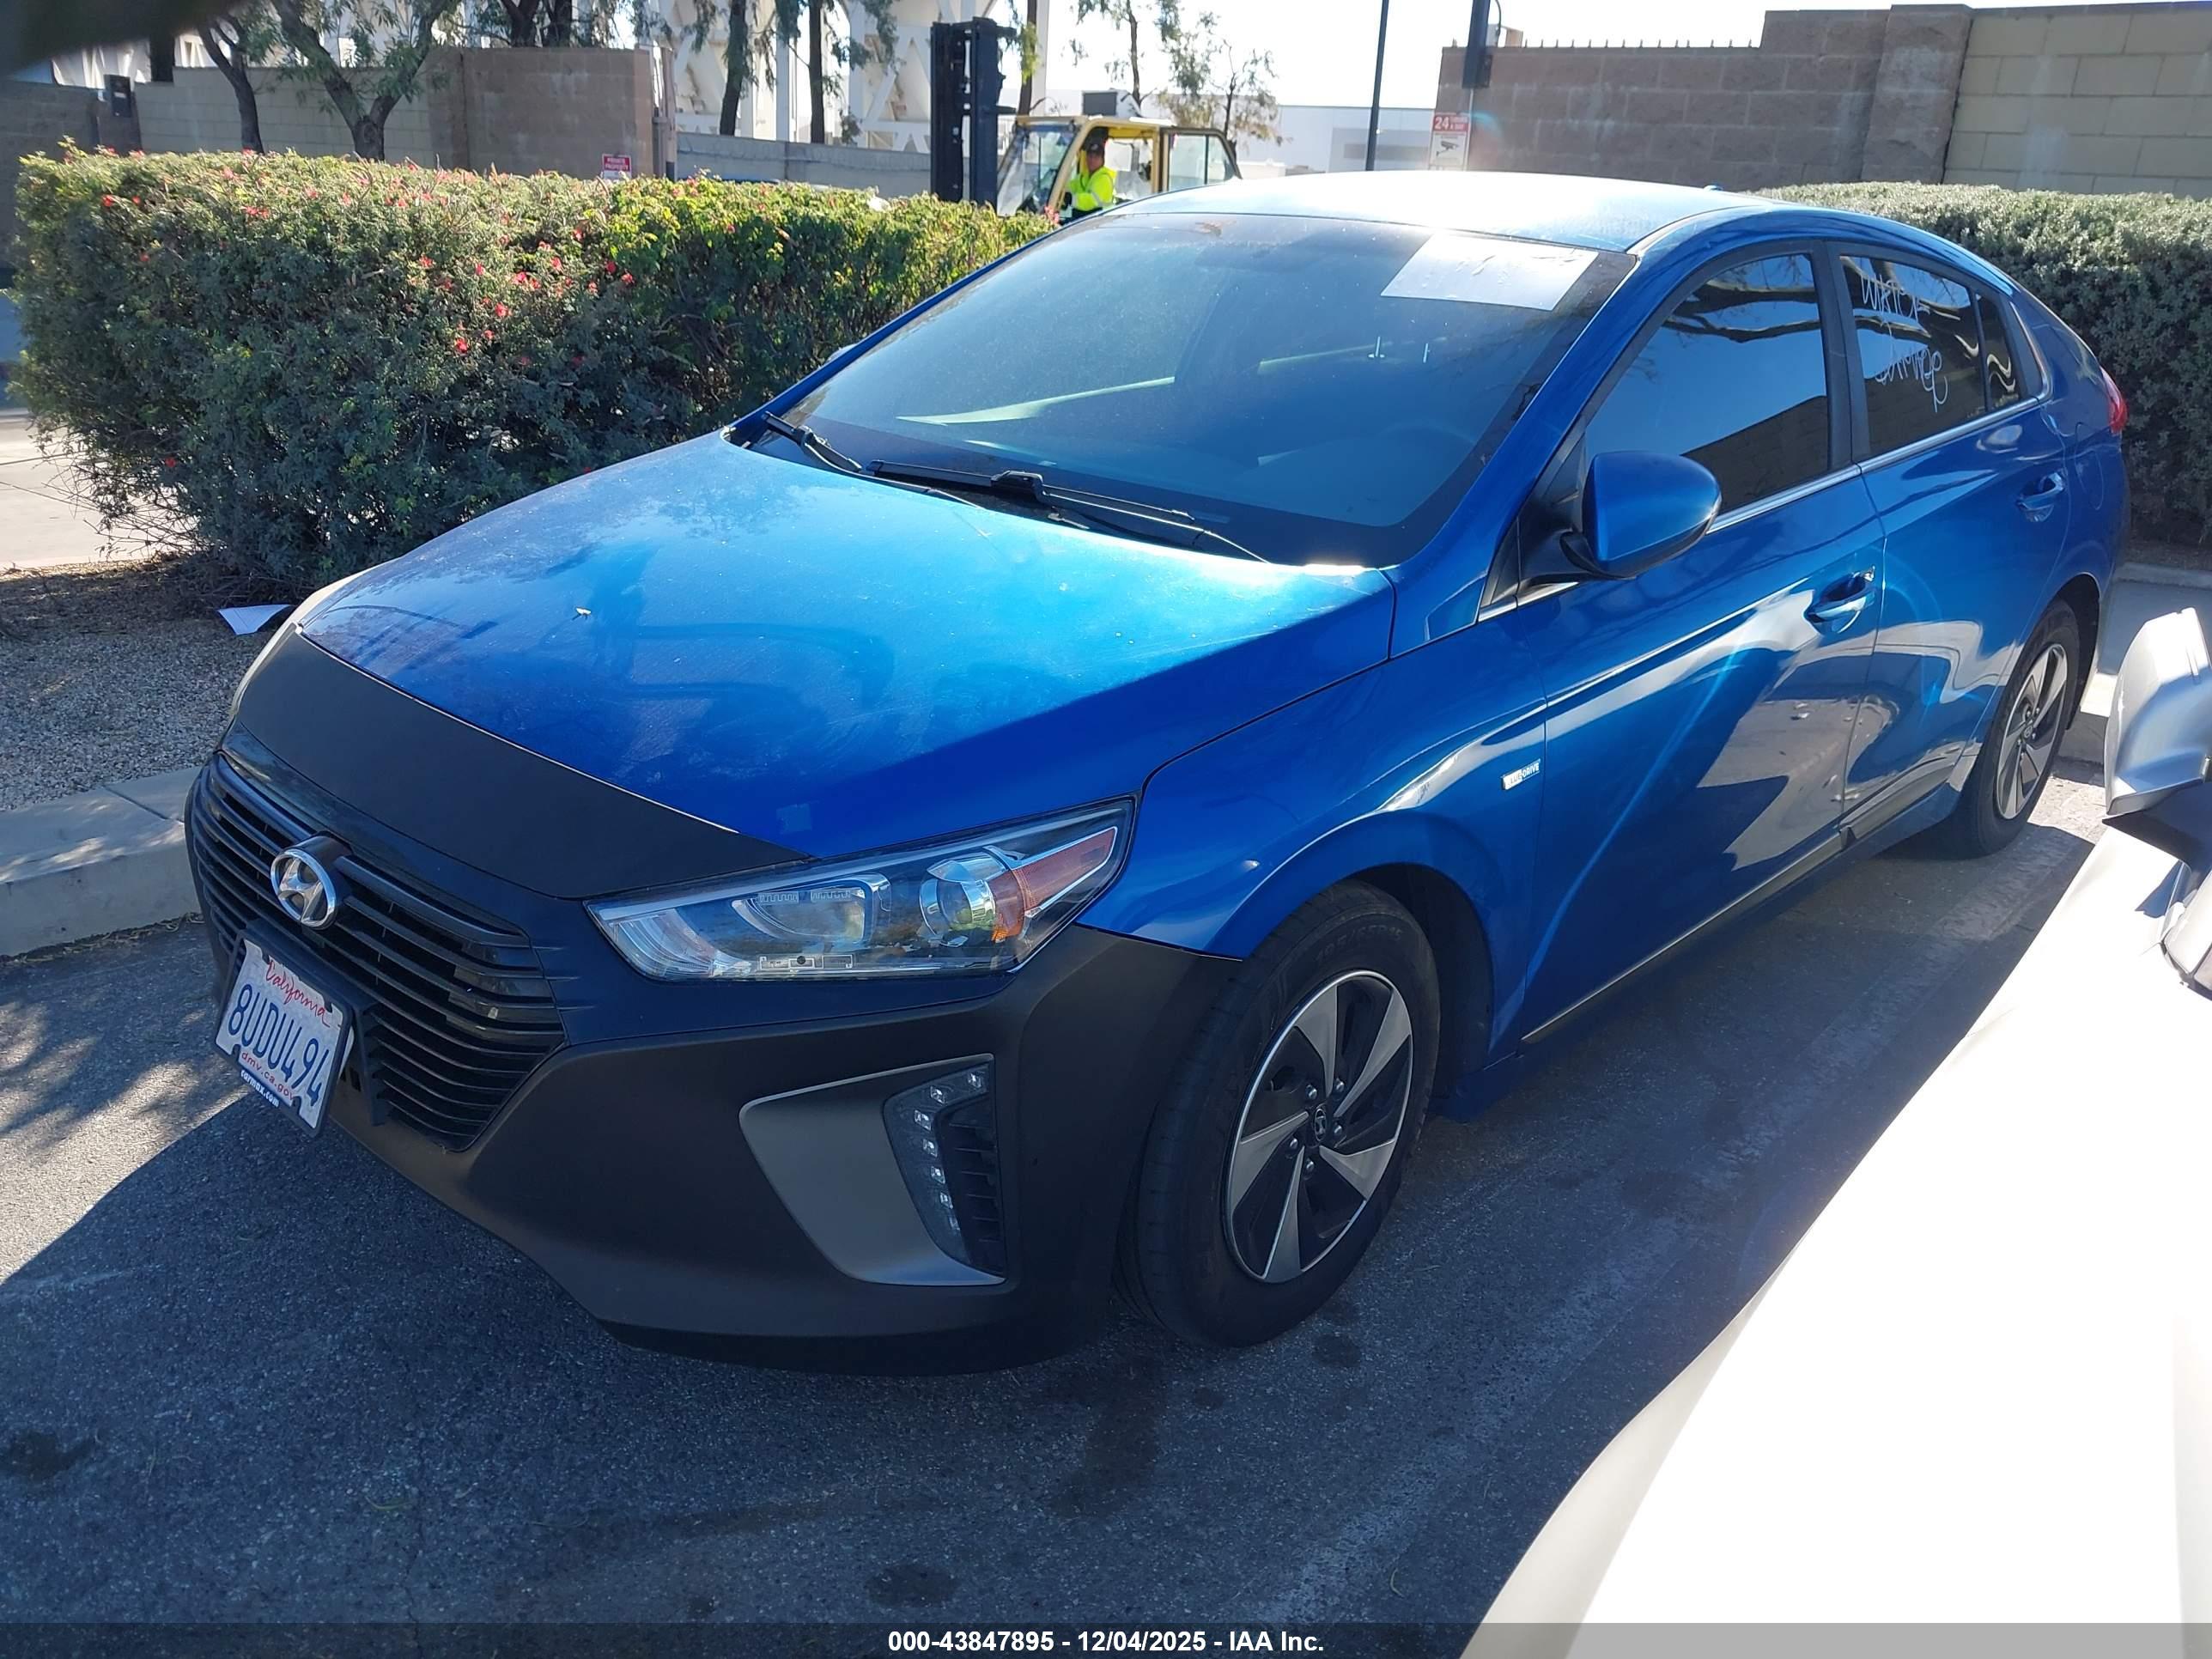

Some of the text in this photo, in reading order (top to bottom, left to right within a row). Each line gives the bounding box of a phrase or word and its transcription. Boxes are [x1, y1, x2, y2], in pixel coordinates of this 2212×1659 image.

[1434, 116, 1449, 130] 24
[265, 960, 331, 1028] California
[228, 983, 330, 1107] 8UDU494
[240, 1069, 280, 1108] carmax.com
[241, 1052, 295, 1100] dmv.ca.gov
